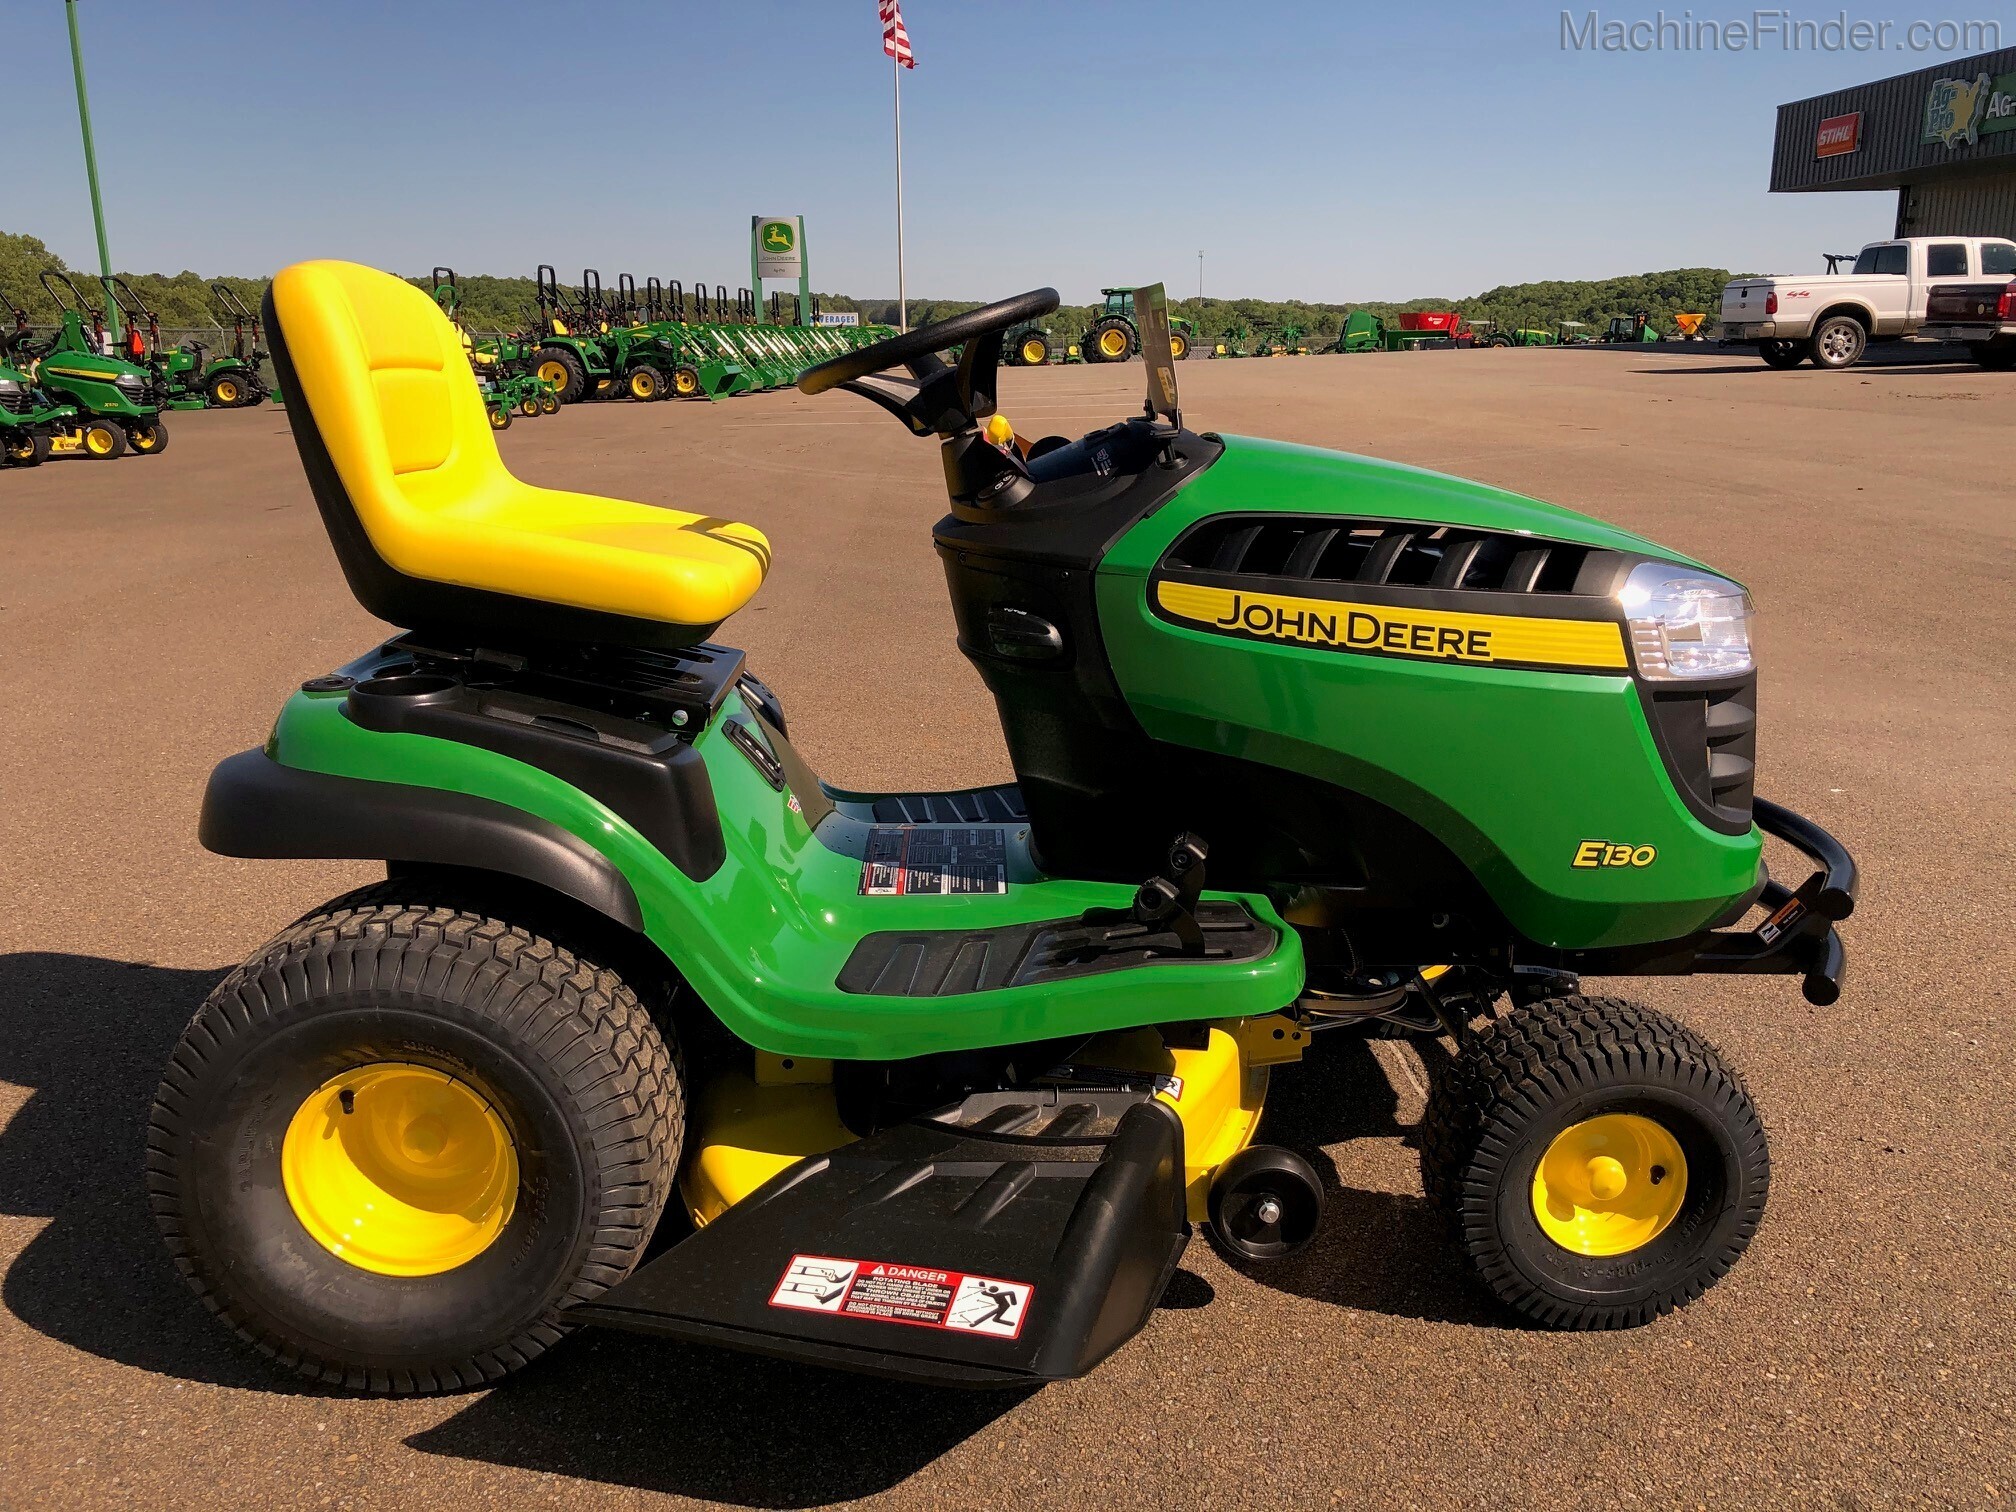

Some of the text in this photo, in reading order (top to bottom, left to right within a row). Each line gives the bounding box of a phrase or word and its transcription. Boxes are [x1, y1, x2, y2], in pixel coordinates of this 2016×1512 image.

[1926, 109, 1955, 136] Pro
[1819, 125, 1850, 145] STIHL
[809, 315, 855, 323] VERAGES
[1217, 595, 1492, 657] JOHN DEERE
[1571, 841, 1656, 868] E130
[873, 1277, 912, 1285] ROTATING
[887, 1267, 948, 1282] DANGER
[865, 1288, 936, 1301] THROWN OBJECTS
